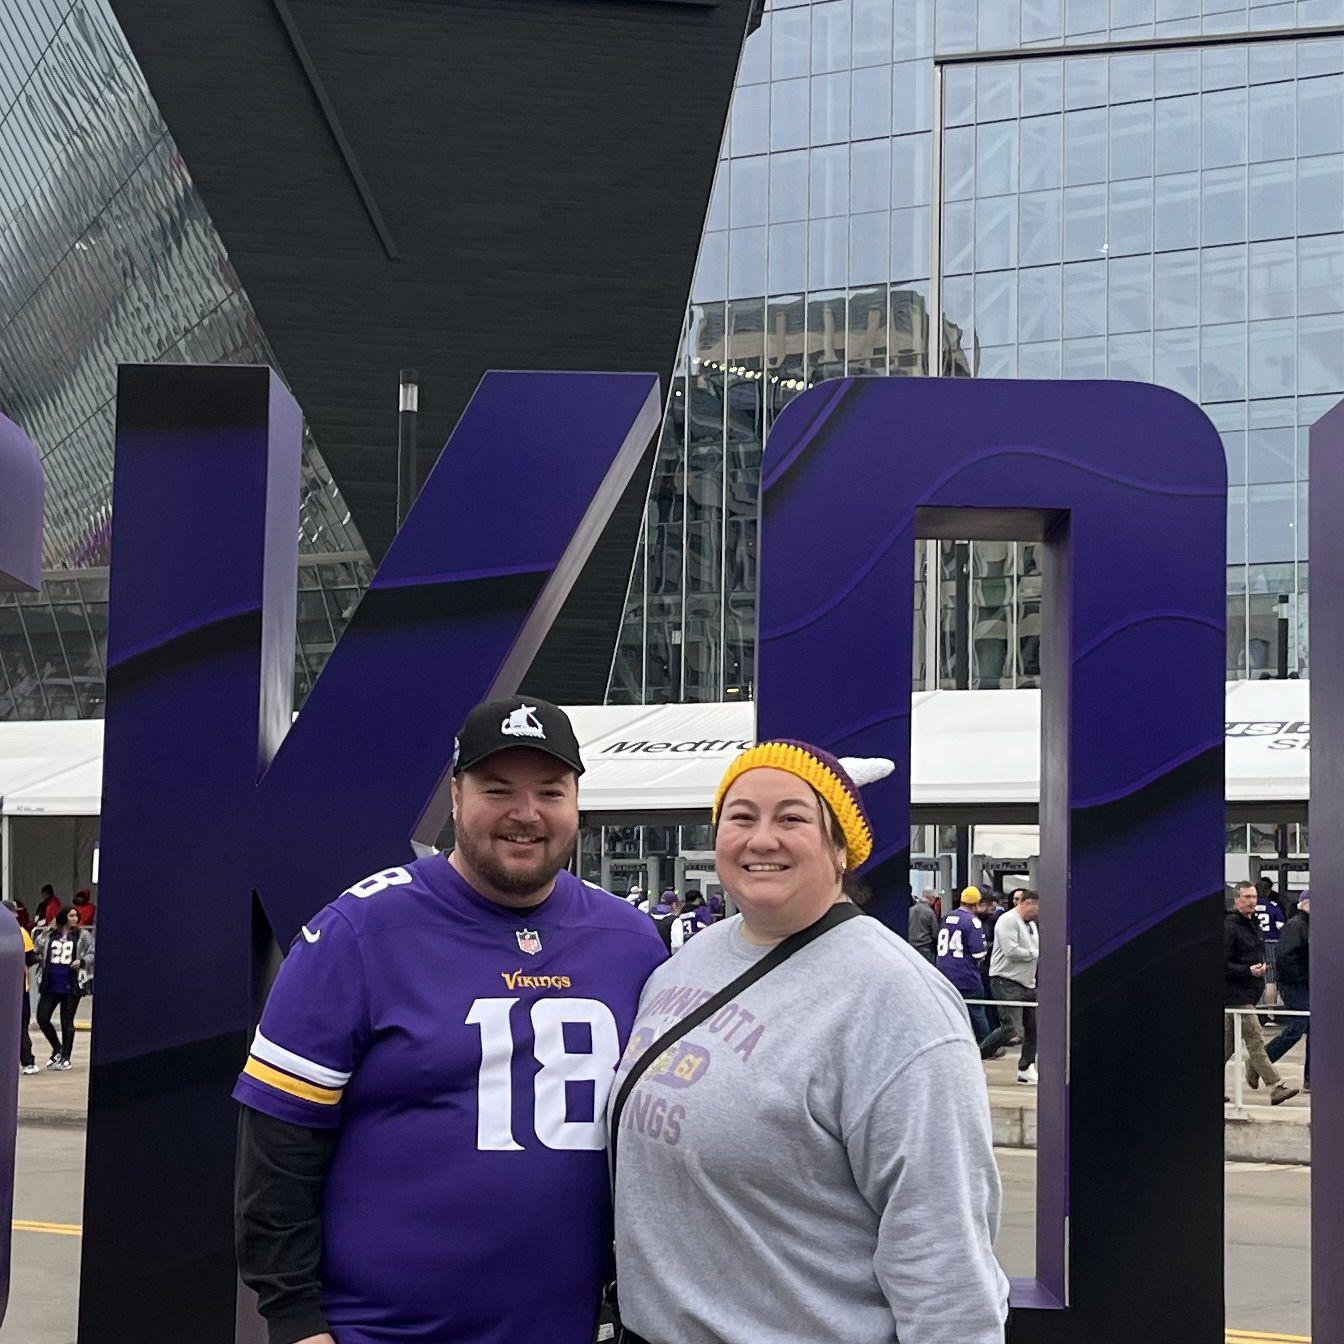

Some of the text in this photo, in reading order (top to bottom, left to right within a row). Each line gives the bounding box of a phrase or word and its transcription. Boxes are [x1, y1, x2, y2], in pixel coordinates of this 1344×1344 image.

[600, 739, 754, 754] Medtro
[338, 866, 413, 899] 8
[50, 940, 74, 965] 28
[937, 928, 964, 958] 84
[464, 997, 621, 1151] 18
